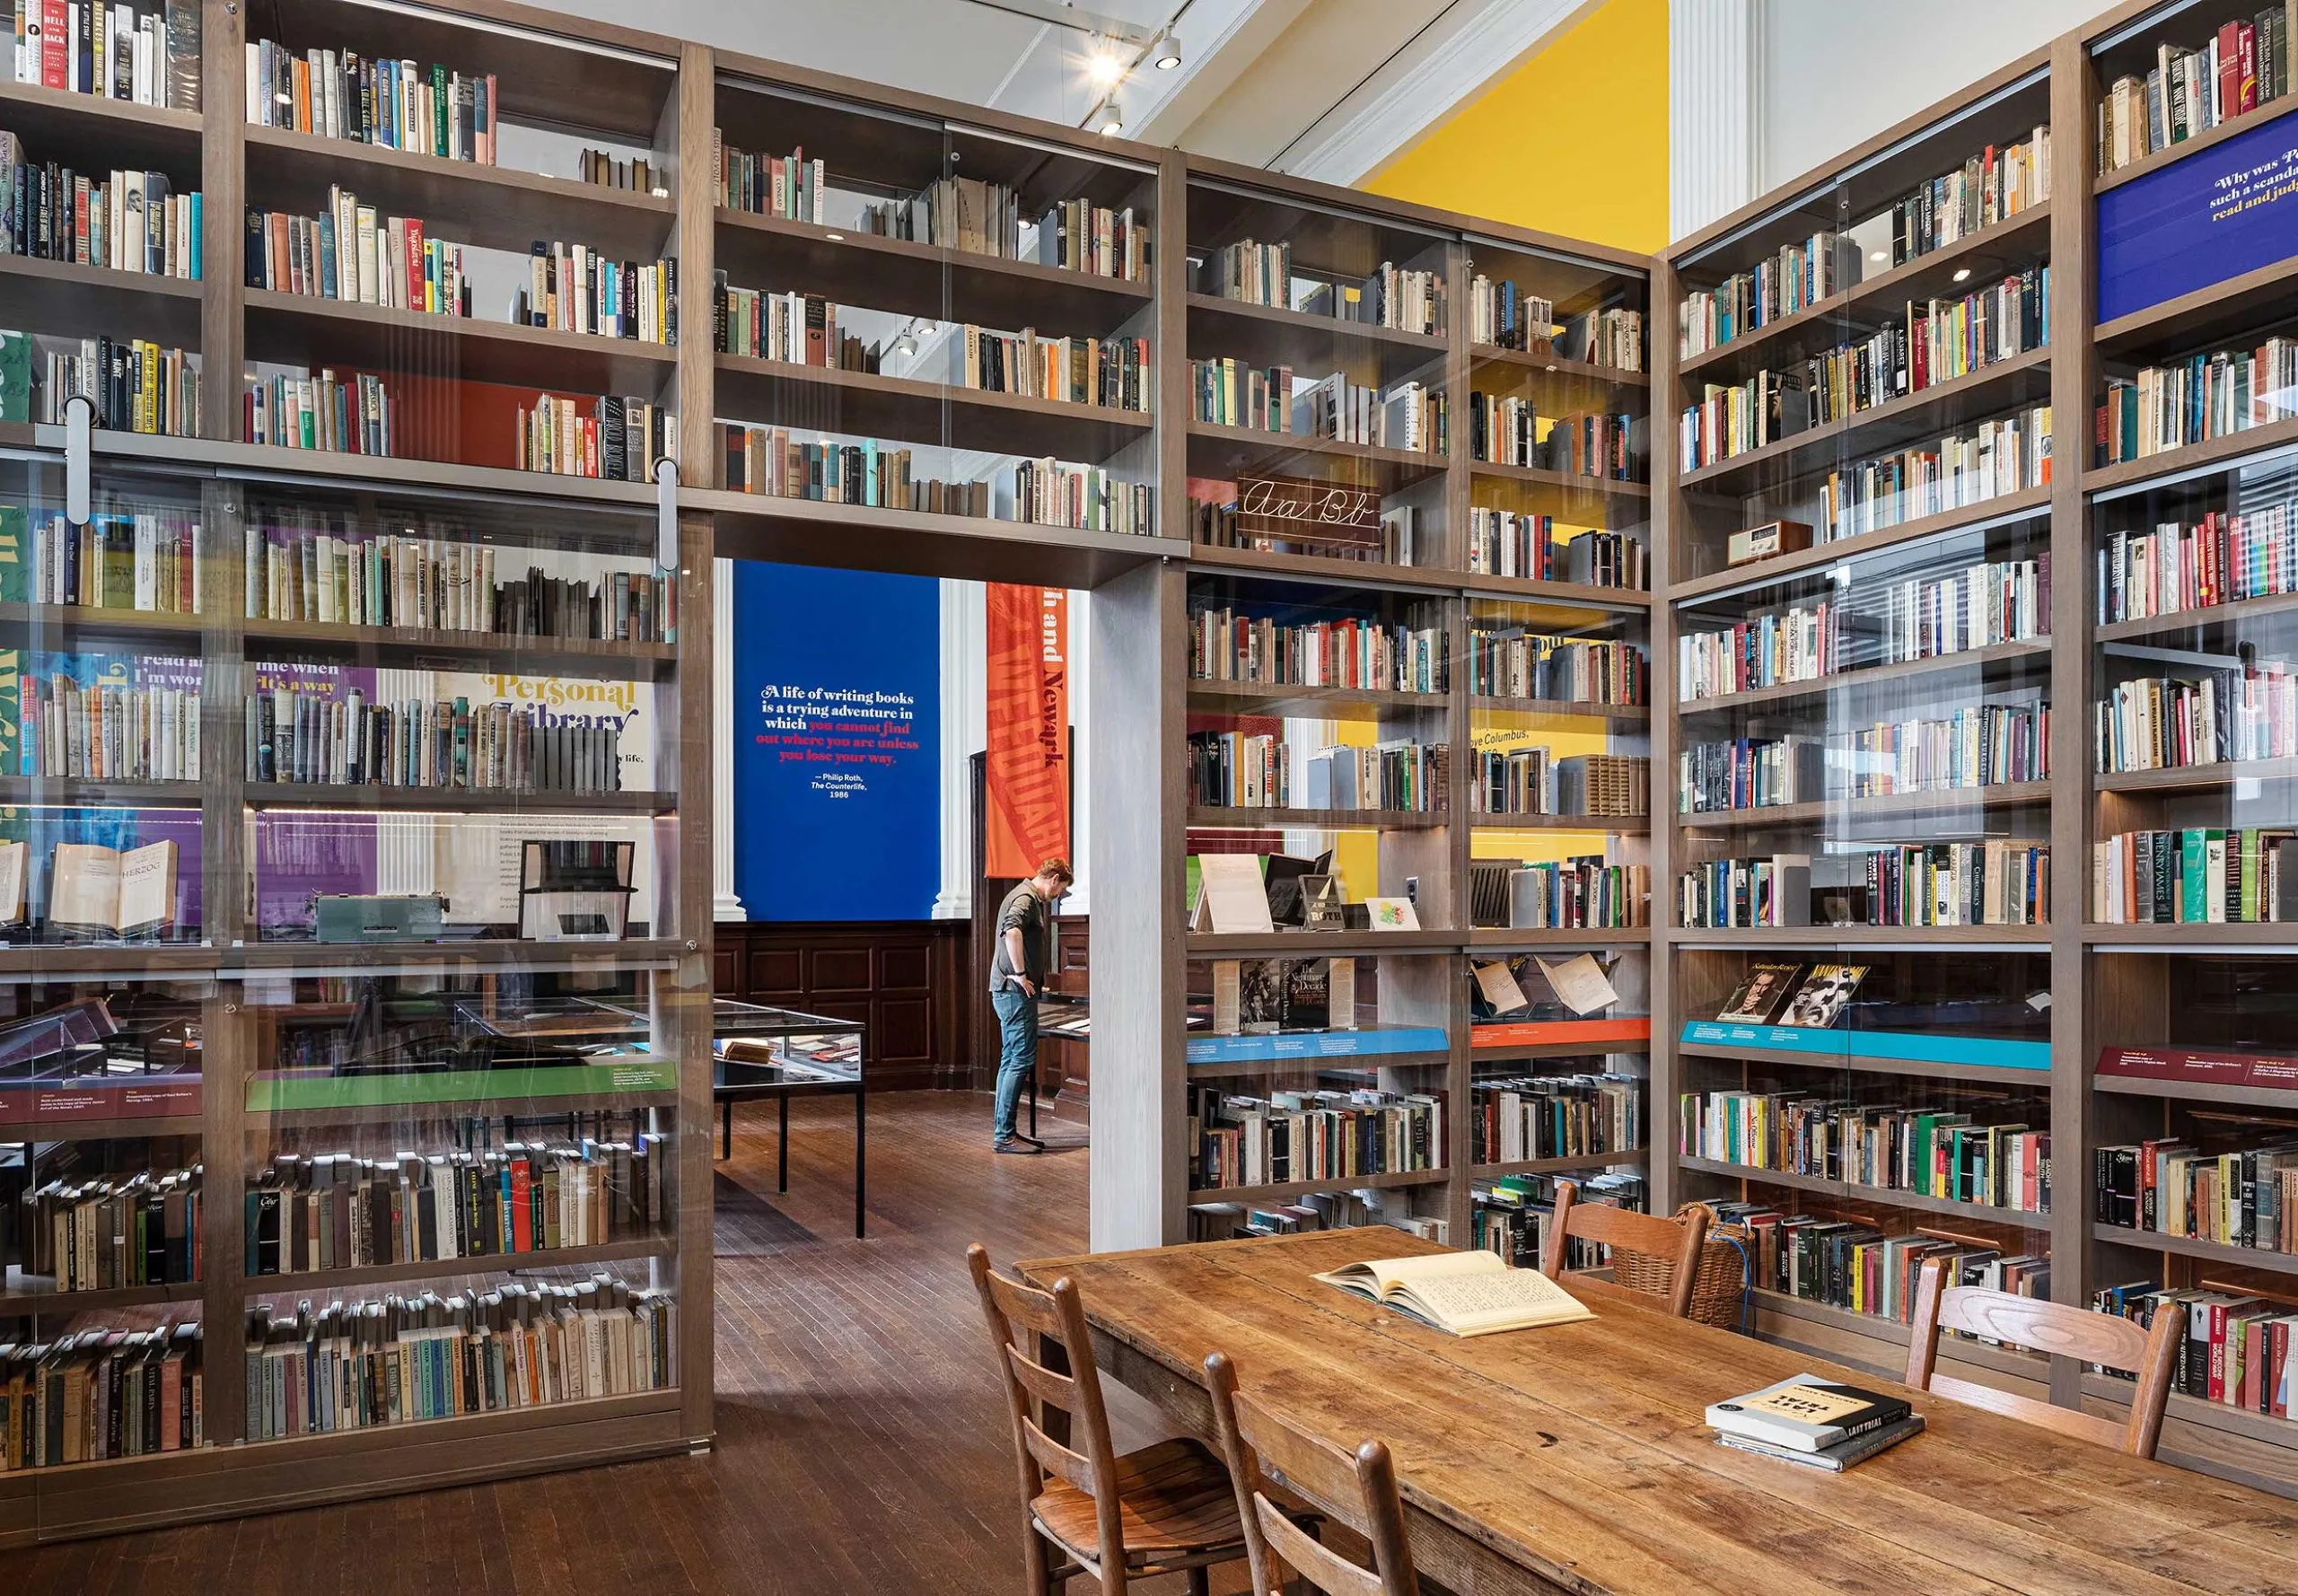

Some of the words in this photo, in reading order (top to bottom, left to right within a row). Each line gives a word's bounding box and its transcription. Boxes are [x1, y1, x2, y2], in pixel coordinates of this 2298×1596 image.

[45, 16, 65, 26] HELL
[93, 4, 103, 42] SILENCES
[2263, 19, 2271, 37] ERICH
[44, 33, 66, 44] BACK
[2263, 37, 2271, 62] FROMM
[118, 57, 130, 89] DREAMS
[2171, 57, 2184, 83] JEALOUSY
[2171, 87, 2184, 104] NANCY
[2171, 103, 2184, 126] FRIDAY
[714, 151, 720, 162] LO
[2215, 169, 2251, 190] Why
[2251, 159, 2278, 176] was
[2209, 189, 2241, 209] such
[2242, 187, 2251, 196] a
[2212, 203, 2243, 223] read
[2244, 191, 2271, 210] and
[343, 204, 351, 238] GARDEN
[343, 240, 351, 267] MAGIC
[408, 228, 419, 267] Yugoslavia
[146, 348, 154, 362] WAKE
[112, 358, 122, 379] HUNT
[146, 387, 154, 414] JONATHAN
[146, 415, 154, 429] AMES
[606, 417, 623, 442] HAROLD
[606, 444, 623, 471] BRODKEY
[1042, 618, 1064, 662] and
[293, 662, 339, 675] when
[482, 673, 636, 712] Personal
[761, 685, 780, 698] A
[782, 686, 805, 698] life
[808, 688, 824, 699] of
[824, 689, 874, 706] writing
[875, 691, 914, 705] books
[490, 701, 640, 739] ibrary
[762, 701, 774, 713] is
[776, 704, 784, 714] a
[786, 705, 829, 718] trying
[831, 705, 898, 719] adventure
[899, 707, 914, 720] in
[1039, 670, 1065, 769] Newark
[765, 717, 807, 731] which
[809, 721, 833, 732] you
[835, 721, 881, 734] cannot
[880, 720, 911, 737] find
[1484, 730, 1530, 745] Columbus.
[756, 732, 779, 744] out
[782, 733, 823, 746] where
[827, 736, 851, 749] you
[853, 739, 875, 749] are
[877, 739, 919, 750] unless
[778, 750, 804, 763] you
[805, 749, 831, 762] lose
[834, 752, 866, 764] your
[868, 754, 897, 767] way.
[822, 774, 844, 782] Philip
[829, 791, 849, 799] 1986
[2155, 836, 2165, 866] HENRY
[2226, 832, 2239, 887] TOCQUEVILLE
[121, 861, 161, 879] HERZOG
[2155, 871, 2165, 900] JAMES
[1751, 1116, 1758, 1124] No
[1768, 1399, 1819, 1416] LAST
[1778, 1394, 1830, 1412] TRIAL
[1847, 1423, 1864, 1437] LAST
[1864, 1416, 1882, 1432] TRIAL
